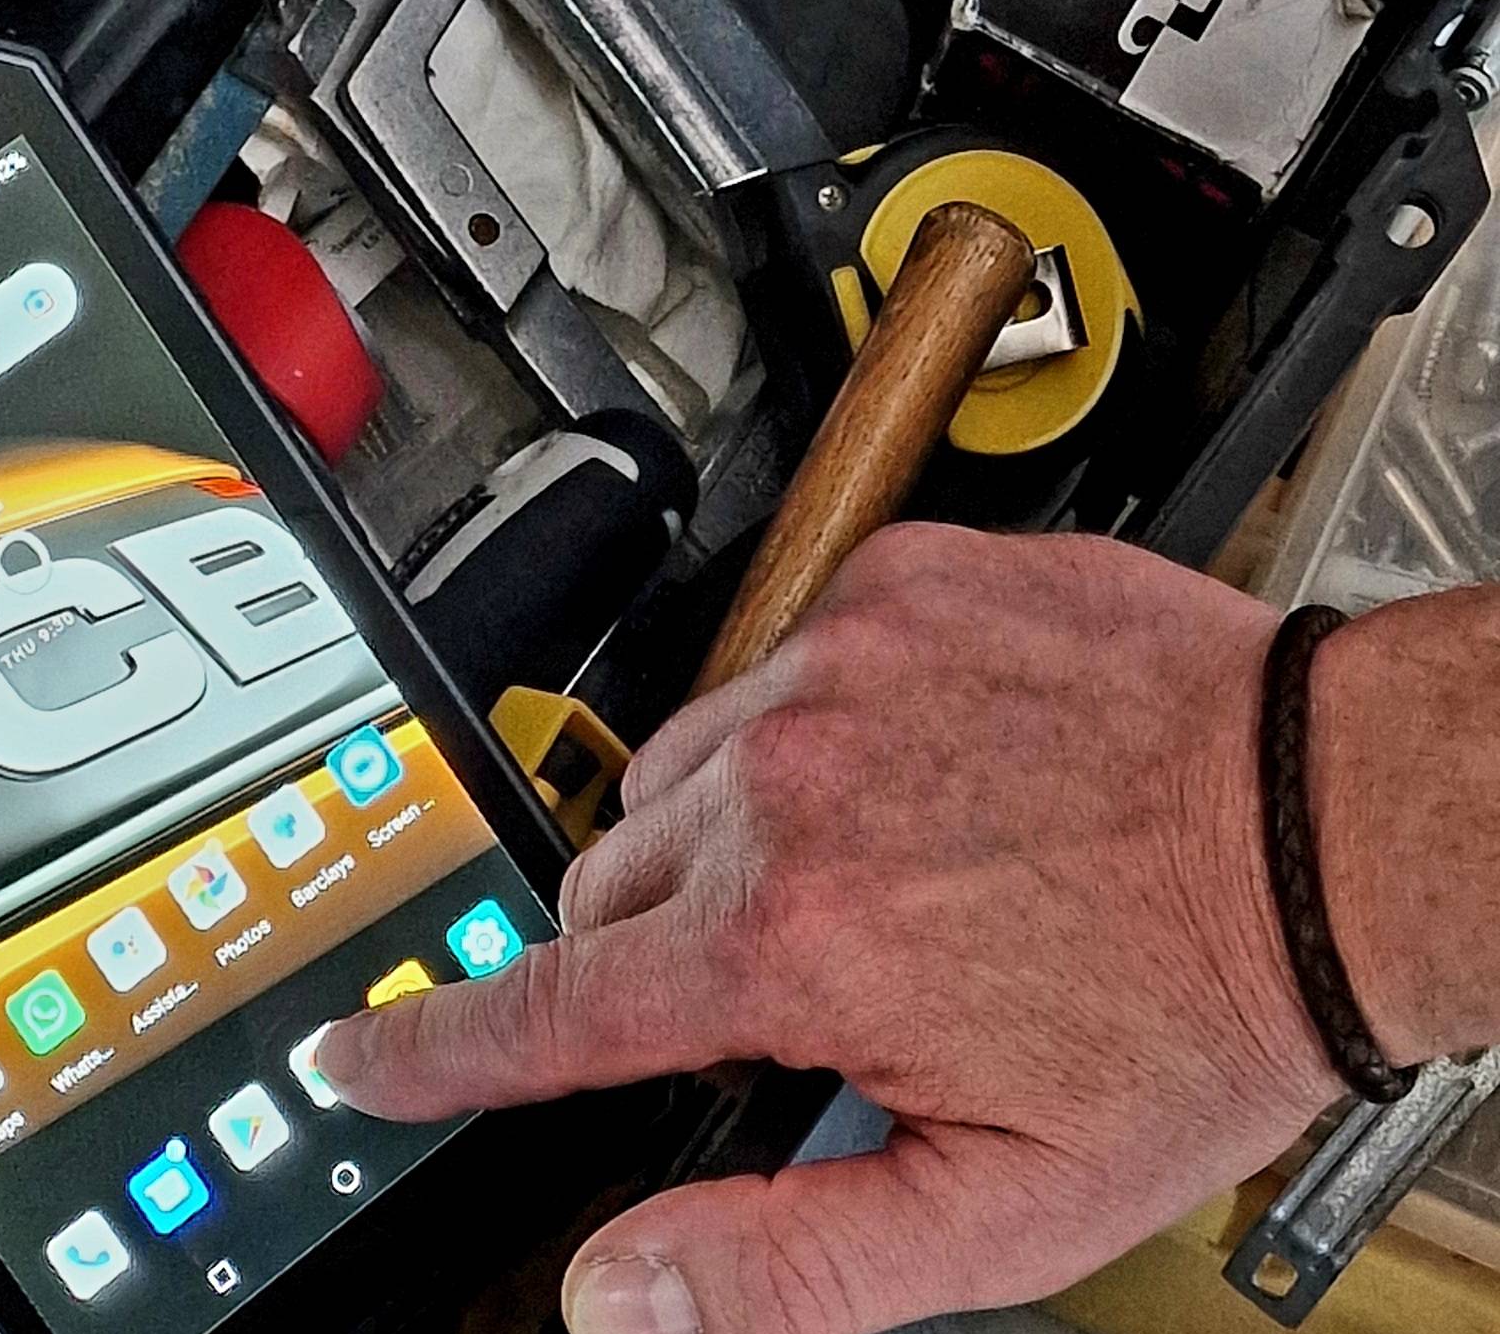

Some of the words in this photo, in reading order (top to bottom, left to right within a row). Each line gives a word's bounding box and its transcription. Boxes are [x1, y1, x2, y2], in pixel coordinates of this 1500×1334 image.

[0, 637, 37, 669] THU
[290, 853, 356, 909] Barclays
[214, 919, 272, 968] Photos
